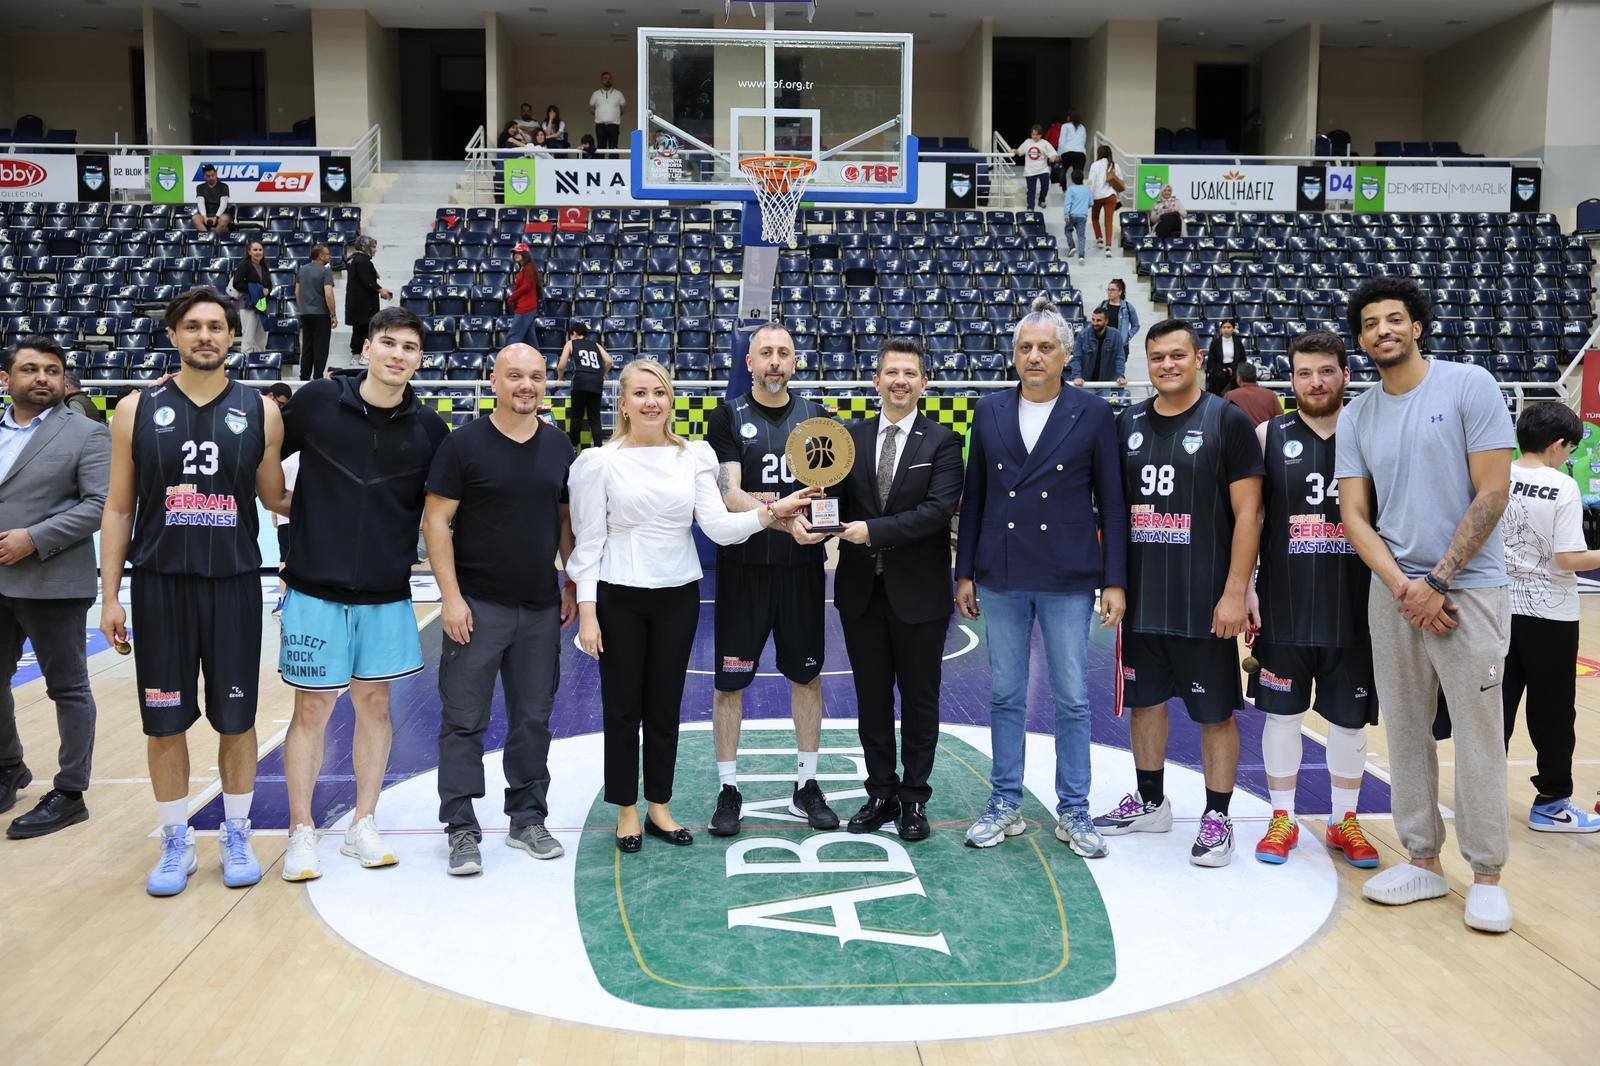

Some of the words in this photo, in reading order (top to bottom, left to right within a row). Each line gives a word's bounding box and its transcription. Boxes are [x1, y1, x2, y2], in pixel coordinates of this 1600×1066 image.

[113, 168, 123, 176] D2
[125, 168, 143, 176] BLOK
[204, 164, 259, 179] UKA
[861, 165, 899, 182] TBF
[274, 175, 307, 190] tel
[1329, 174, 1353, 192] D4
[578, 349, 600, 369] 39
[181, 440, 219, 475] 23
[761, 453, 797, 484] 20
[1140, 464, 1175, 496] 98
[1305, 472, 1340, 505] 34
[1512, 481, 1560, 501] PIECE
[286, 650, 314, 663] ROCK
